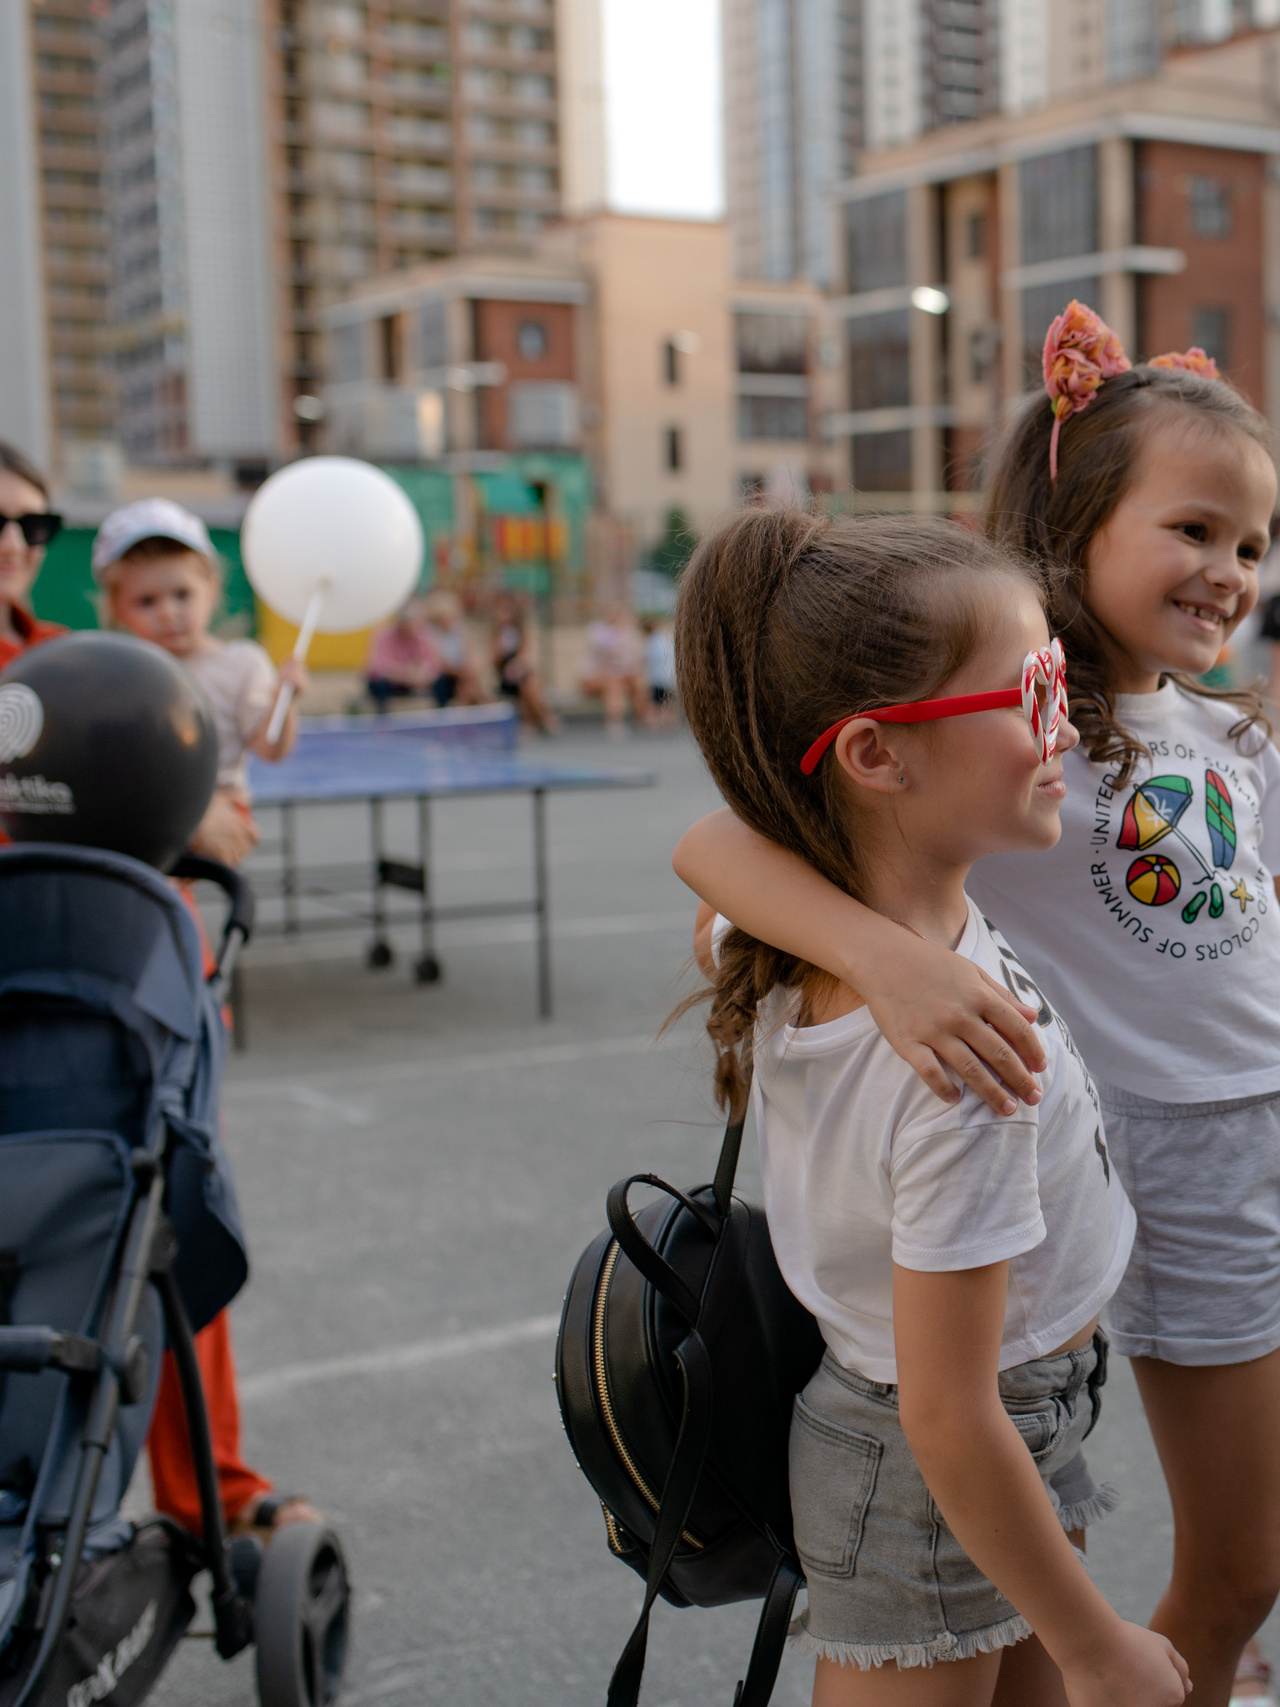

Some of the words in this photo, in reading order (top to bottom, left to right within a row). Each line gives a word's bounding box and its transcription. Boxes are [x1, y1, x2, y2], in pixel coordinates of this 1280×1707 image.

[1174, 743, 1197, 761] OF
[1090, 861, 1154, 944] SUMMER
[1156, 938, 1187, 959] OF
[1195, 917, 1260, 961] COLORS
